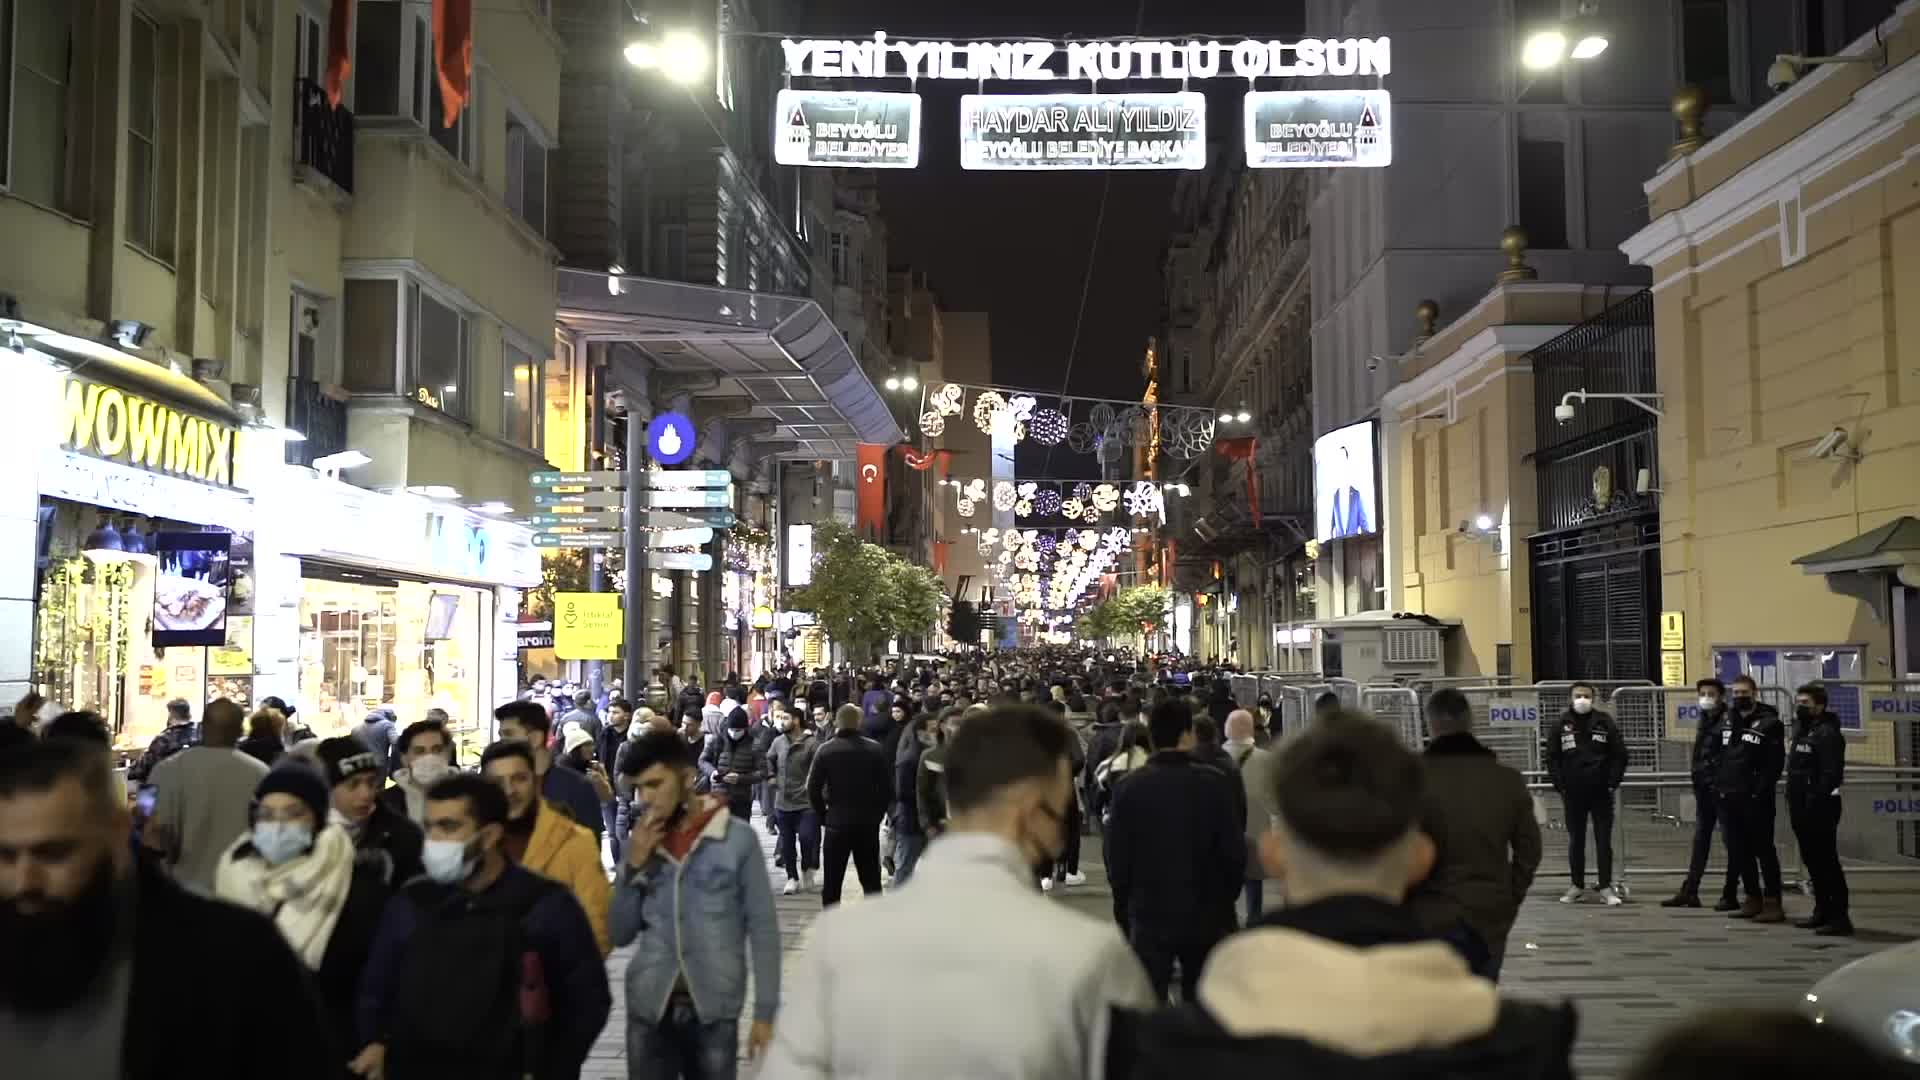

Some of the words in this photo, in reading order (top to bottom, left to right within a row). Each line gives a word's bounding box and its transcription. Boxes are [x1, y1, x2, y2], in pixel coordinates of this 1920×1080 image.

[781, 31, 887, 78] YENİ
[1067, 40, 1220, 79] KUTLU
[1232, 37, 1391, 78] OLSUN
[815, 120, 897, 139] BEYOĞLU
[968, 106, 1069, 134] HAYDAR
[1073, 104, 1114, 134] ALİ
[1121, 107, 1199, 133] YILDIZ
[1270, 119, 1353, 139] BEYOĞLU
[1046, 137, 1127, 159] BELEDİYE
[1490, 704, 1537, 721] POLİS
